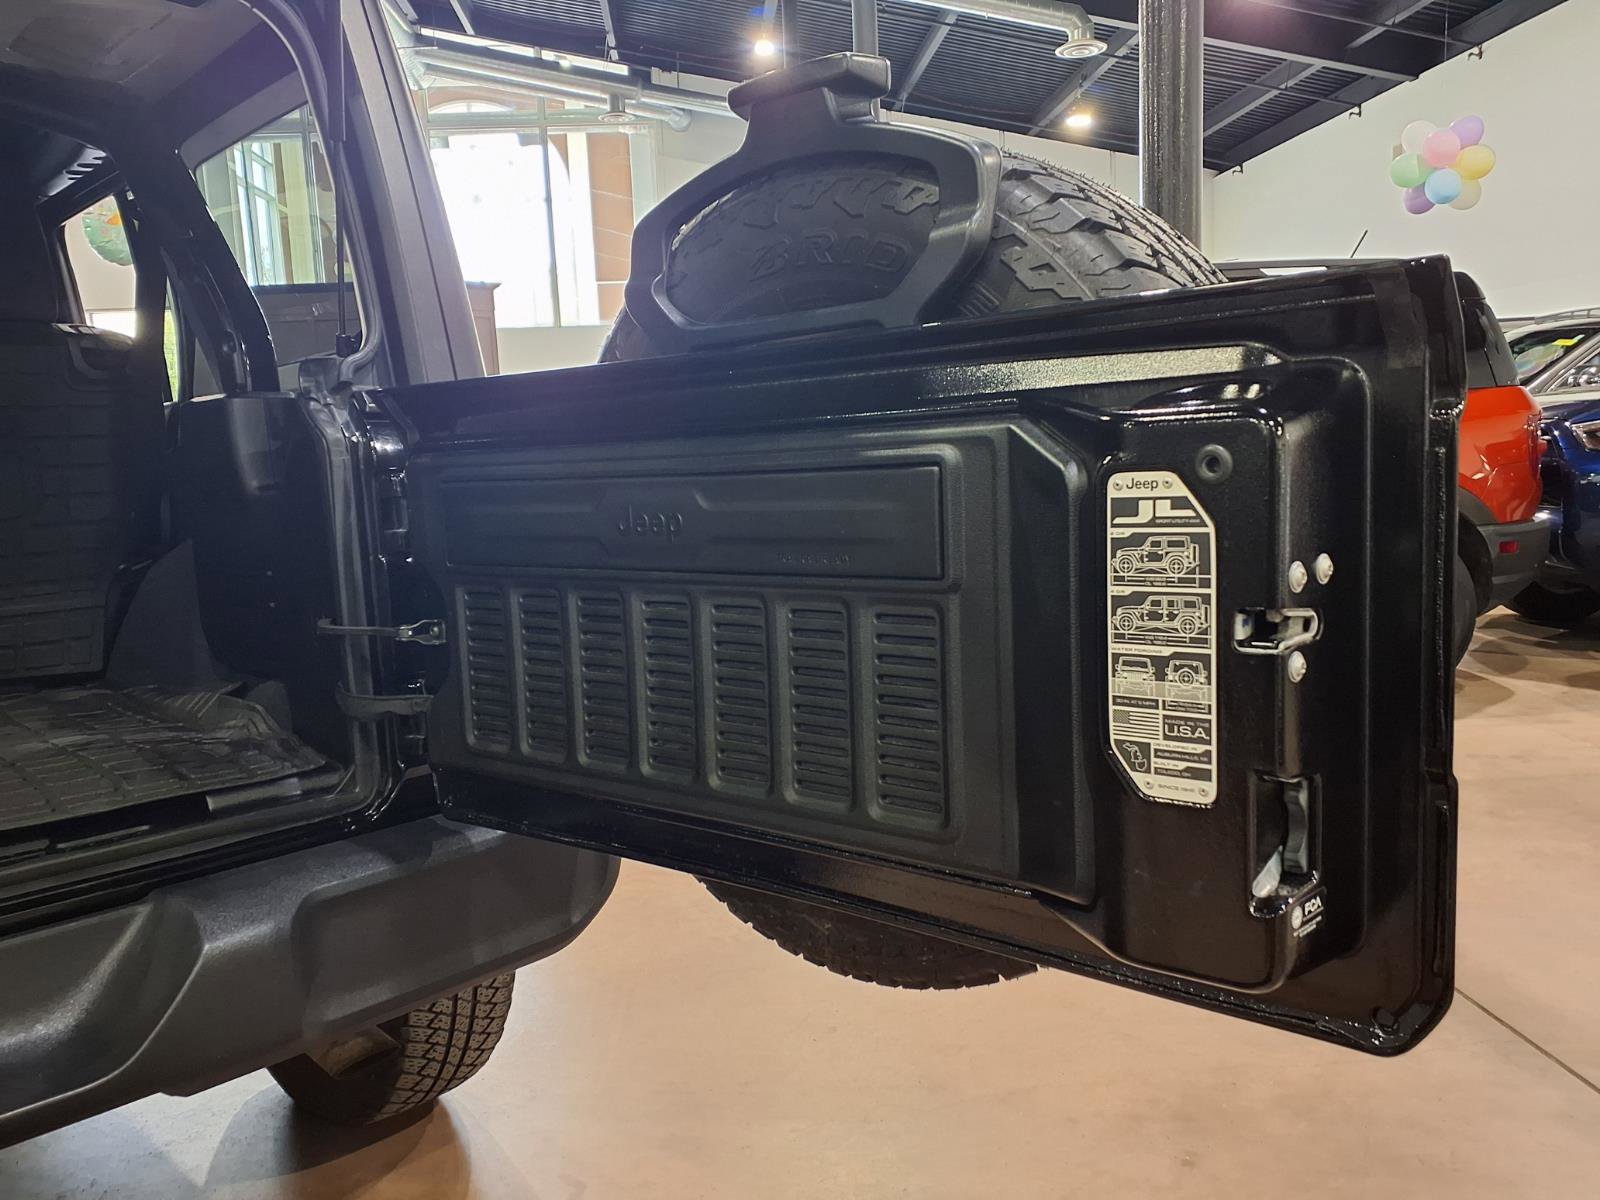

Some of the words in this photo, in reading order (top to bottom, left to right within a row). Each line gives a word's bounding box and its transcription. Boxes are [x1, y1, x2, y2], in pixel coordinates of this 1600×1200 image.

[1126, 478, 1159, 491] Jeep
[1112, 499, 1197, 524] JL
[617, 503, 684, 544] Jeep
[1164, 724, 1210, 740] U.S.A.
